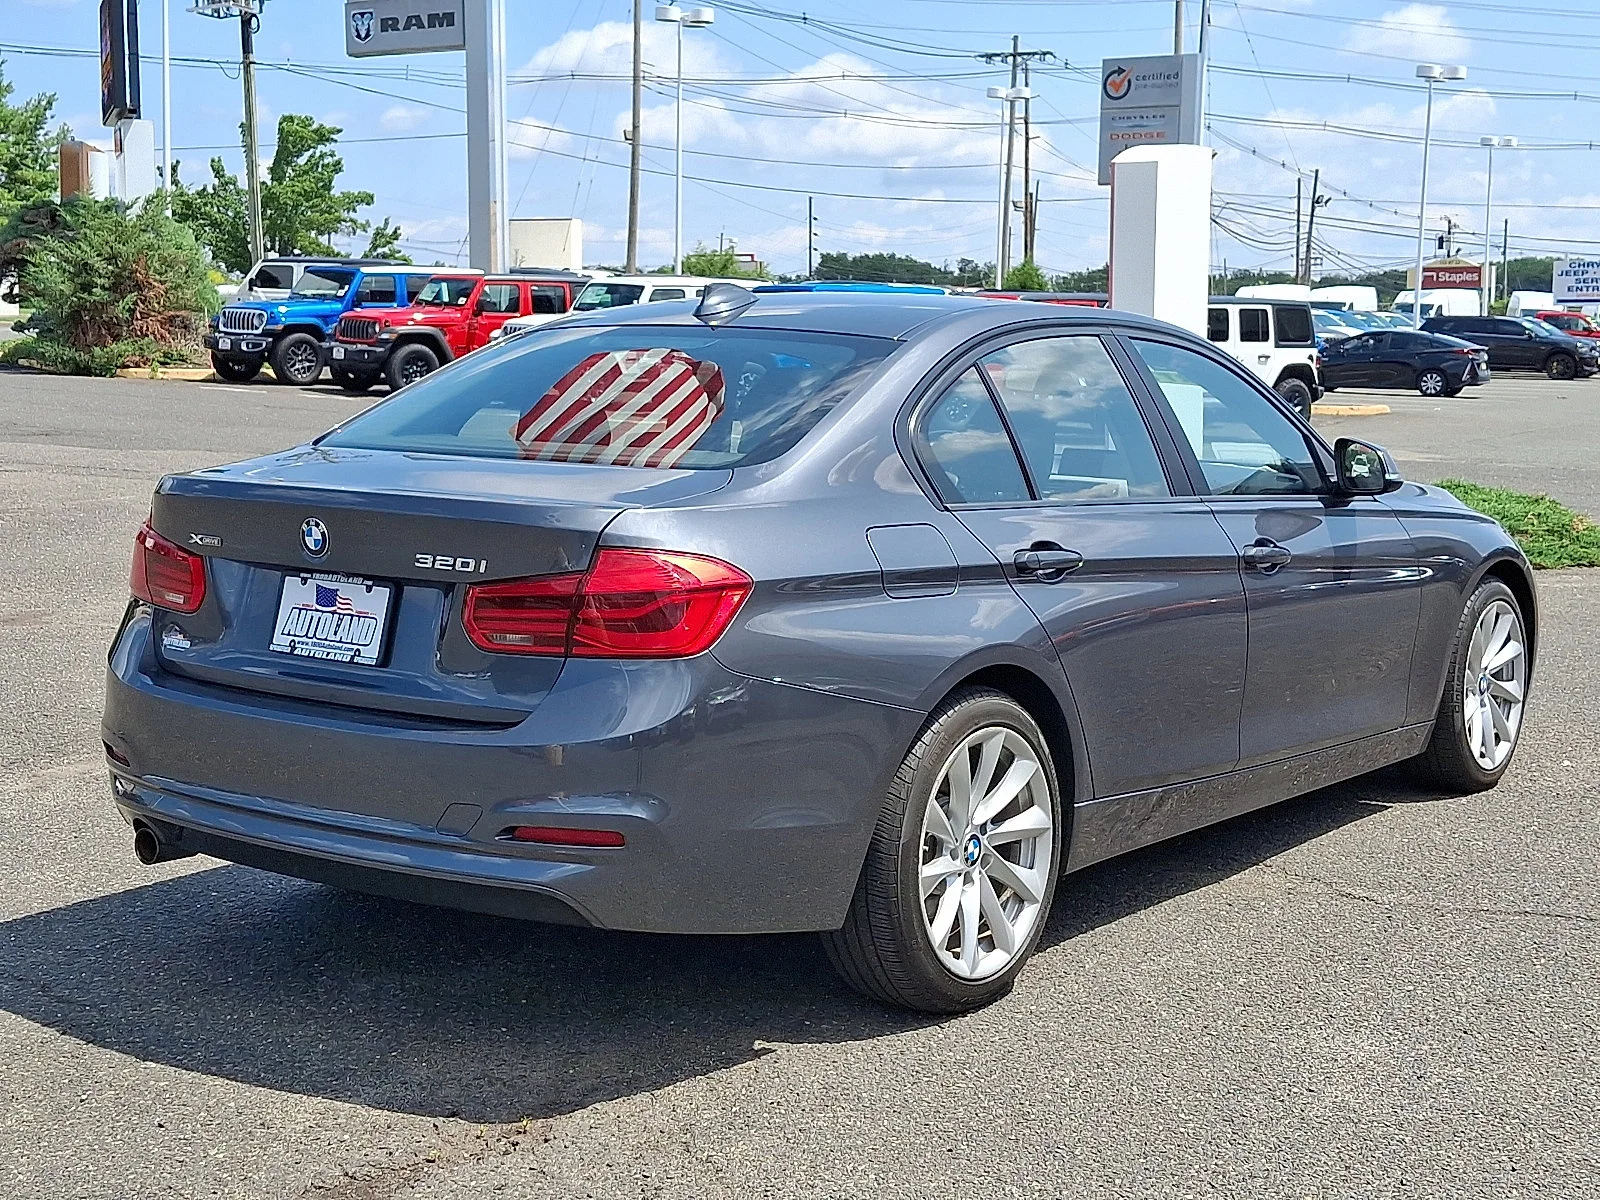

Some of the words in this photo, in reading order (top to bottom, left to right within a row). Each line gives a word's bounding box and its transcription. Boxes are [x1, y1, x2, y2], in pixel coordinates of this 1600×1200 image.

[380, 12, 455, 33] RAM
[1135, 71, 1179, 81] certified
[1110, 131, 1166, 140] DODGE
[1438, 271, 1479, 284] Staples
[282, 608, 377, 645] AUTOLAND
[293, 647, 351, 662] AUTOLAND
